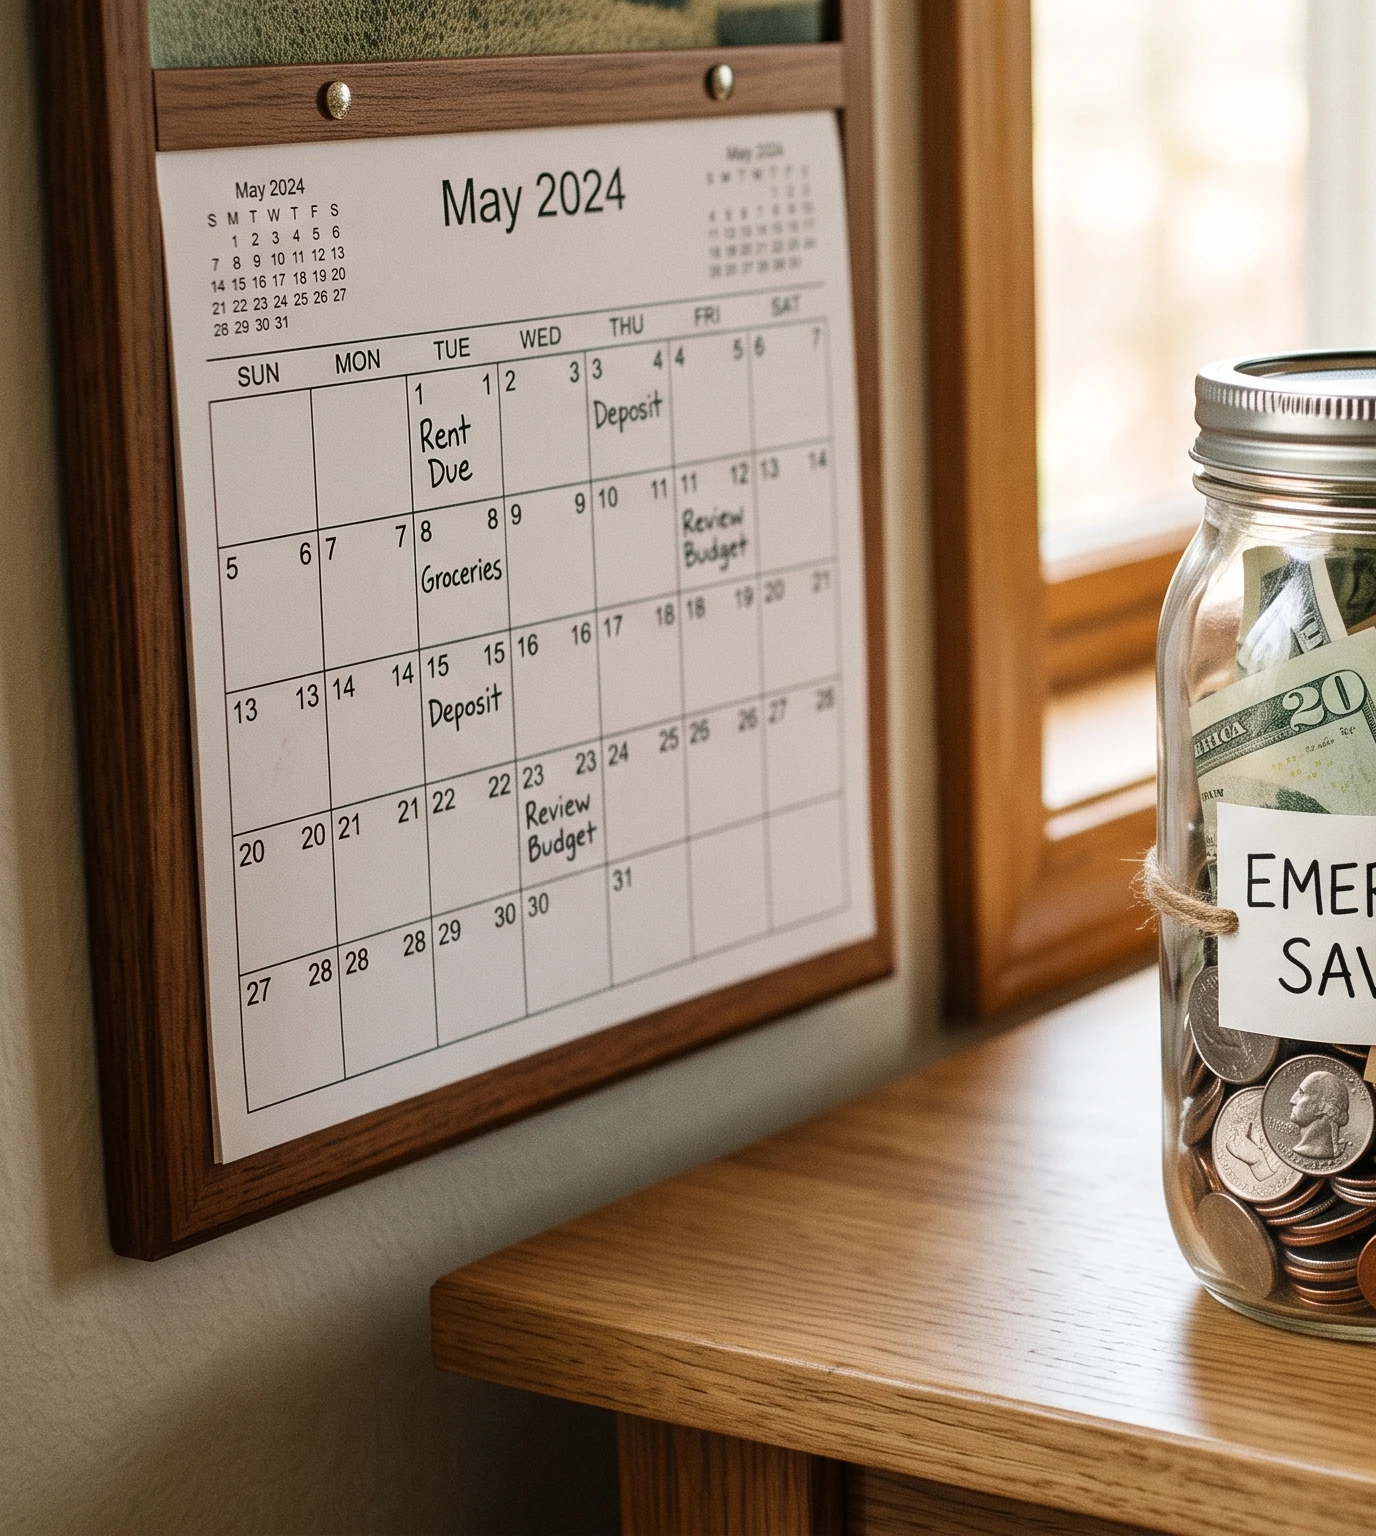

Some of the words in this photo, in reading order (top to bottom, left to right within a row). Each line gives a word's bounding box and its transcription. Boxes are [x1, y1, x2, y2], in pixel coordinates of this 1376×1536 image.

[235, 182, 265, 201] May
[270, 178, 305, 196] 2024
[442, 178, 522, 234] May
[536, 167, 625, 217] 2024
[208, 213, 217, 227] S
[227, 212, 239, 226] M
[249, 209, 258, 224] T
[267, 208, 280, 222] W
[291, 206, 298, 220] T
[311, 205, 318, 218] F
[330, 203, 339, 218] S
[232, 234, 238, 248] 1
[252, 232, 259, 246] 2
[272, 231, 280, 245] 3
[292, 229, 300, 243] 4
[312, 227, 320, 241] 5
[332, 225, 340, 239] 6
[212, 258, 219, 271] 7
[232, 256, 241, 270] 8
[253, 254, 261, 268] 9
[271, 252, 285, 266] 10
[292, 250, 304, 264] 11
[312, 248, 325, 262] 12
[331, 246, 345, 260] 13
[211, 279, 225, 292] 14
[232, 277, 246, 291] 15
[252, 275, 266, 289] 16
[272, 273, 286, 287] 17
[293, 271, 307, 285] 18
[312, 269, 327, 283] 19
[332, 267, 346, 281] 20
[212, 302, 226, 315] 21
[233, 299, 248, 313] 22
[253, 297, 268, 311] 23
[273, 295, 288, 308] 24
[294, 292, 308, 306] 25
[313, 290, 328, 304] 26
[333, 288, 346, 302] 27
[214, 323, 229, 337] 28
[235, 320, 249, 334] 29
[255, 317, 270, 332] 30
[275, 316, 288, 330] 31
[520, 326, 561, 349] WED
[609, 315, 644, 336] THU
[694, 306, 719, 325] FRI
[771, 295, 799, 317] SAT
[238, 362, 279, 387] SUN
[336, 349, 380, 374] MON
[433, 337, 470, 360] TUE
[505, 370, 515, 392] 2
[570, 361, 580, 383] 3
[592, 358, 602, 379] 3
[653, 351, 663, 369] 4
[675, 348, 684, 365] 4
[733, 339, 743, 360] 5
[754, 336, 764, 356] 6
[415, 383, 422, 404] 1
[483, 374, 490, 394] 1
[593, 391, 663, 433] Deposit
[420, 415, 471, 452] Rent
[428, 458, 472, 488] Due
[511, 504, 522, 525] 9
[575, 493, 585, 514] 9
[599, 486, 618, 508] 10
[652, 478, 666, 498] 11
[681, 472, 697, 492] 11
[731, 462, 748, 485] 12
[760, 457, 779, 479] 13
[810, 451, 827, 467] 14
[683, 509, 743, 535] Review
[227, 556, 238, 580] 5
[300, 542, 311, 565] 6
[326, 537, 336, 560] 7
[395, 525, 406, 547] 7
[421, 520, 432, 542] 8
[488, 508, 498, 529] 8
[684, 536, 748, 571] Budget
[421, 559, 502, 593] Groceries
[518, 634, 538, 657] 16
[572, 622, 591, 644] 16
[604, 614, 623, 637] 17
[656, 604, 675, 625] 18
[687, 597, 705, 618] 18
[735, 586, 754, 607] 19
[234, 698, 257, 723] 13
[296, 684, 319, 709] 13
[333, 675, 355, 699] 14
[392, 662, 414, 686] 14
[428, 654, 449, 678] 15
[484, 641, 505, 665] 15
[1282, 669, 1365, 732] 20
[428, 684, 502, 731] Deposit
[523, 764, 544, 789] 23
[576, 750, 597, 775] 23
[609, 742, 628, 766] 24
[240, 840, 264, 867] 20
[302, 823, 325, 850] 20
[338, 813, 359, 840] 21
[398, 797, 418, 823] 21
[433, 788, 455, 814] 22
[489, 773, 510, 798] 22
[525, 794, 591, 829] Review
[528, 822, 597, 863] Budget
[528, 892, 549, 917] 30
[613, 868, 631, 891] 31
[247, 977, 271, 1006] 27
[309, 959, 332, 986] 28
[346, 948, 368, 975] 28
[404, 930, 426, 957] 28
[439, 919, 461, 946] 29
[495, 903, 516, 928] 30
